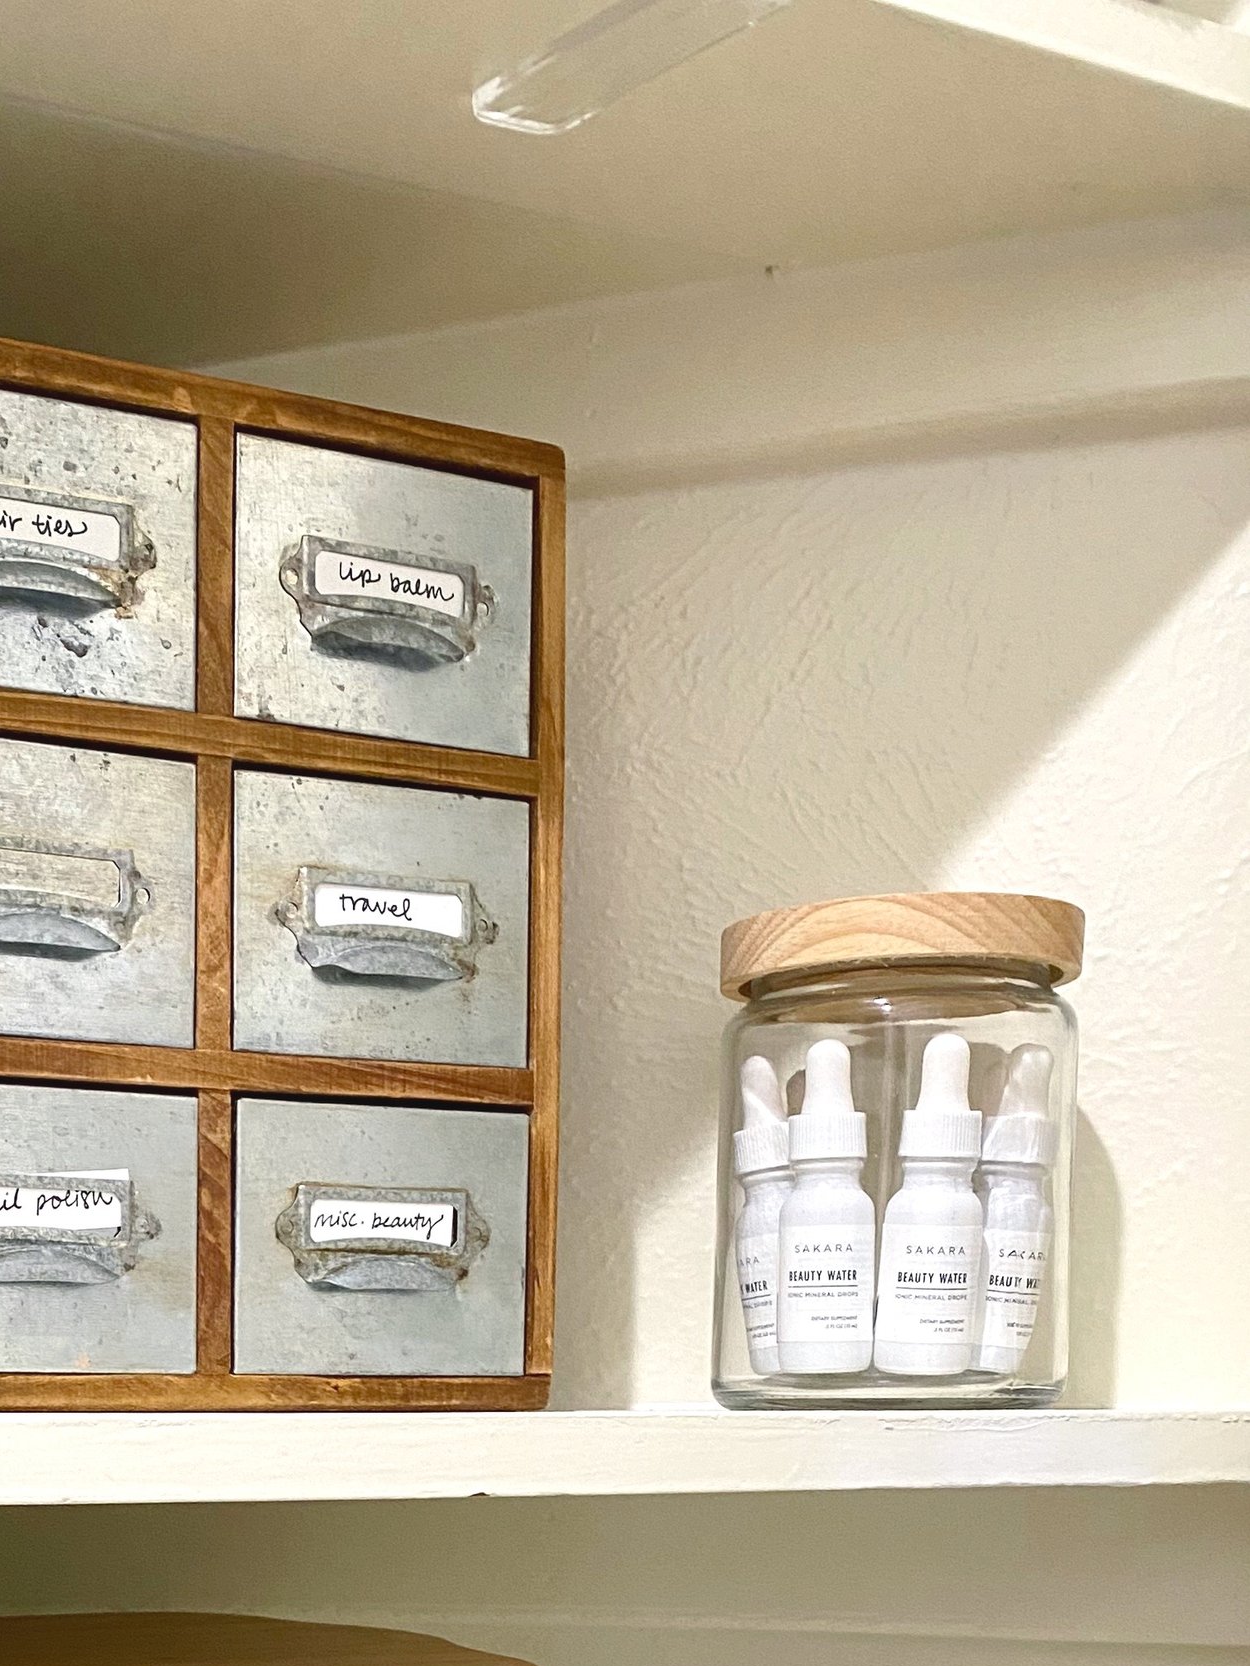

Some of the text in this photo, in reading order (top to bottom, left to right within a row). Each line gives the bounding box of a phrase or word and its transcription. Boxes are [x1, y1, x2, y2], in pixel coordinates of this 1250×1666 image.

[31, 514, 88, 537] ties
[339, 561, 455, 602] lip balm
[339, 893, 413, 922] travel
[314, 1210, 445, 1241] misc. beauty
[794, 1243, 854, 1254] SAKARA
[906, 1245, 967, 1256] SAKARA
[998, 1248, 1047, 1261] SAKAR
[788, 1269, 858, 1282] BEAUTY WATER
[897, 1271, 968, 1284] BEAUTY WATER
[745, 1279, 769, 1294] WATER
